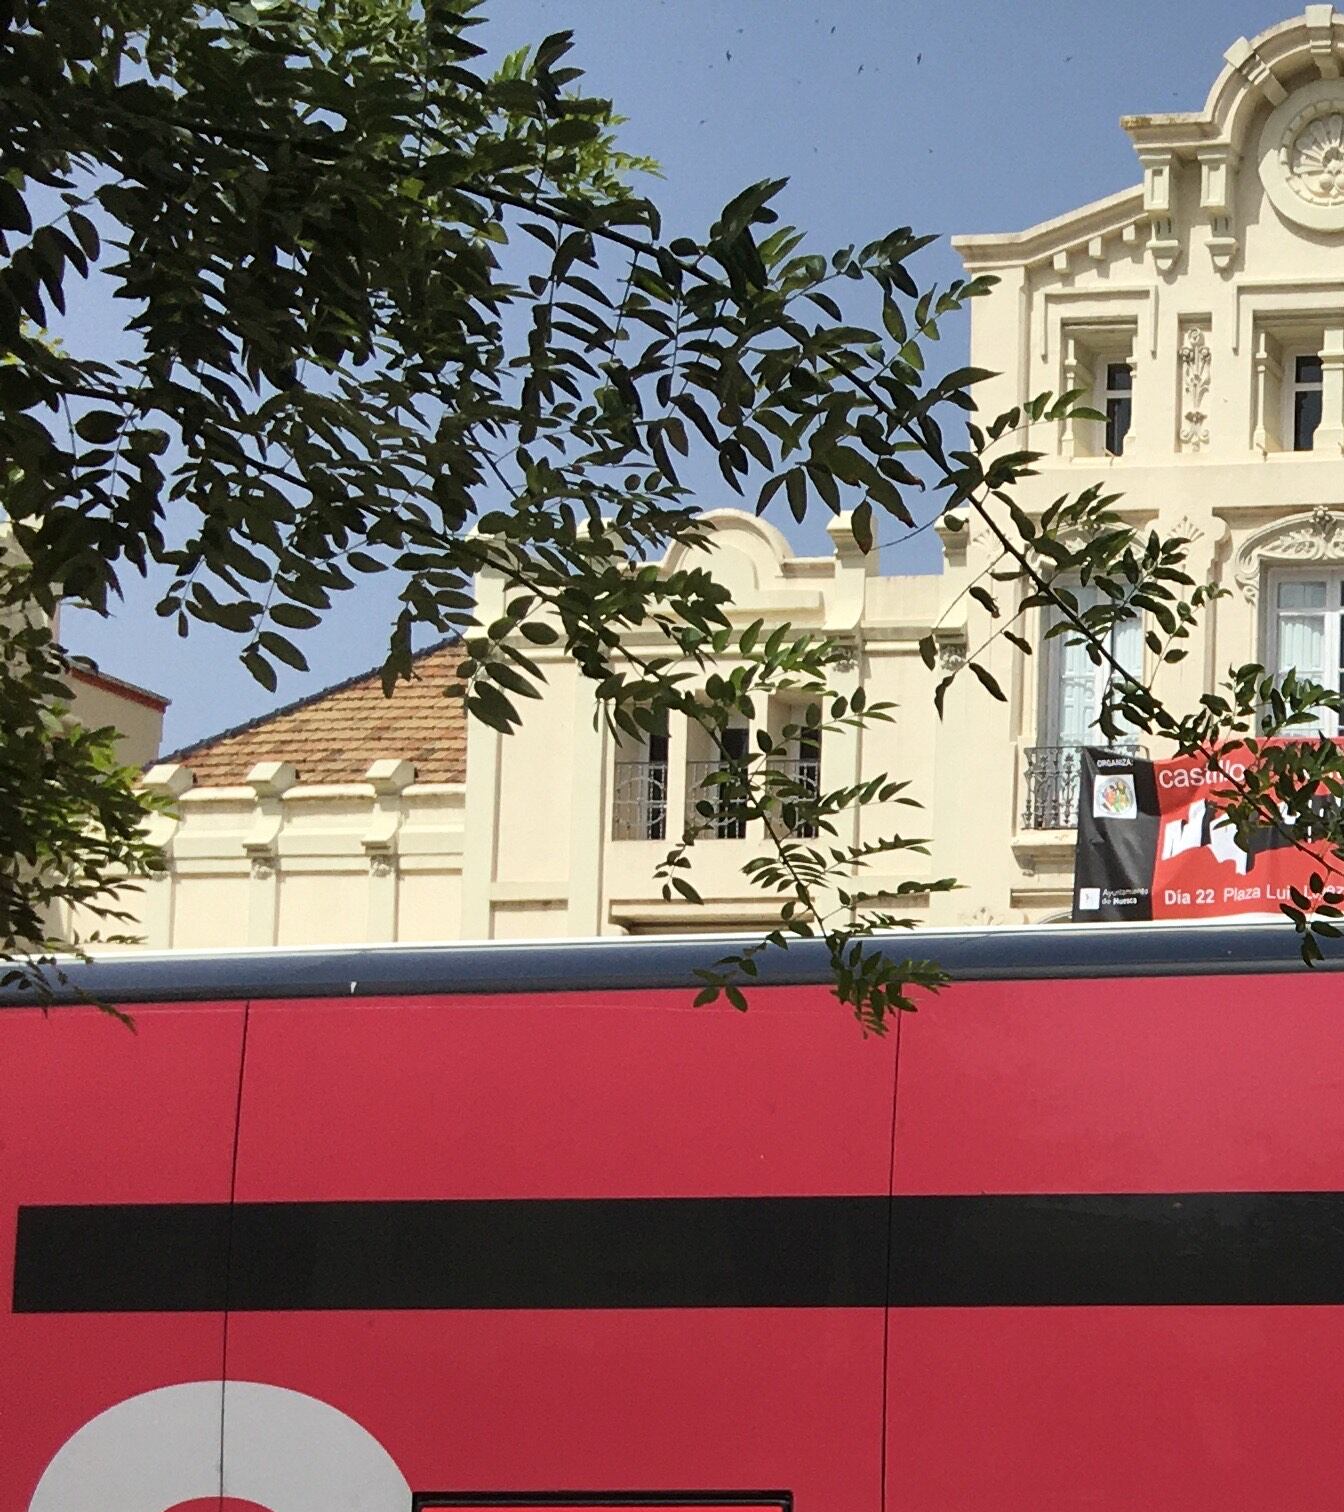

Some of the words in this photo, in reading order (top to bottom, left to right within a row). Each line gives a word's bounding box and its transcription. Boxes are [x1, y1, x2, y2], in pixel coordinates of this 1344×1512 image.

[1164, 889, 1191, 905] Día
[1195, 888, 1215, 905] 22
[1223, 887, 1261, 902] Plaza
[1266, 884, 1292, 899] Lui
